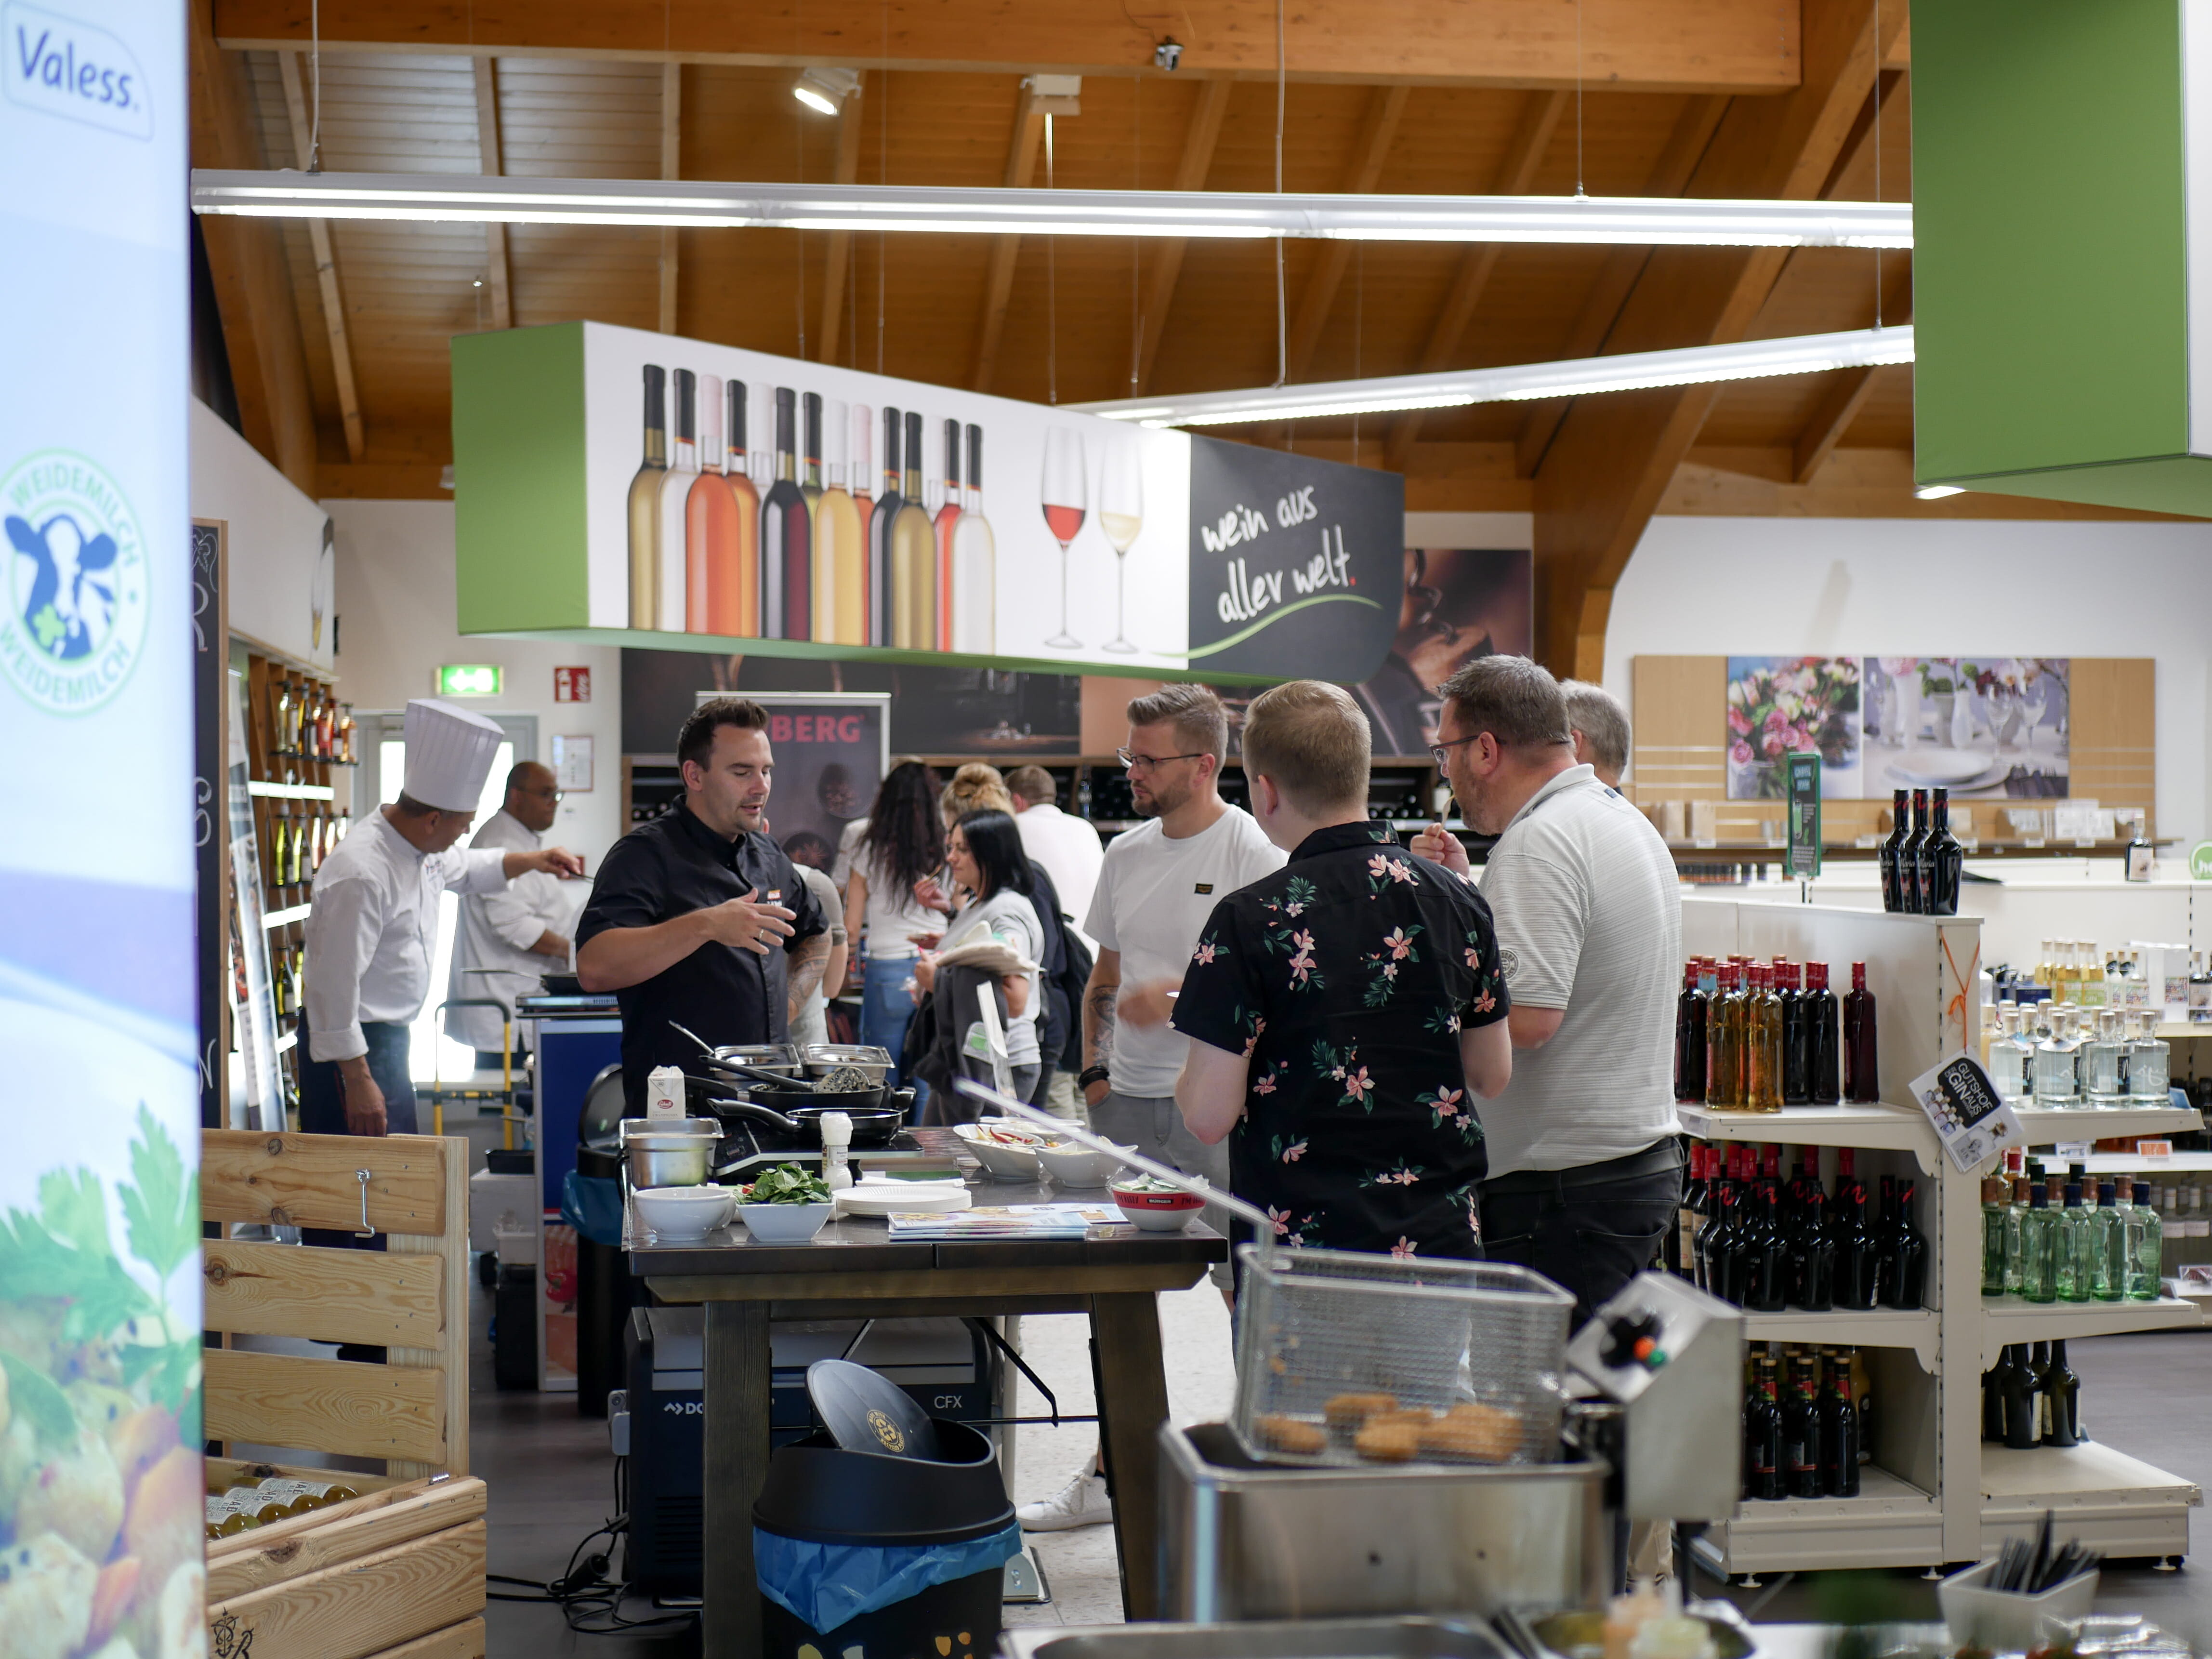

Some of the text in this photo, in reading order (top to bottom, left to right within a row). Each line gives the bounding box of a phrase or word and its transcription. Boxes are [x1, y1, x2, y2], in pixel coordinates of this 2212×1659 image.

[10, 464, 139, 567] WEIDEMILCH
[1201, 485, 1318, 553] wein aus
[1217, 557, 1283, 624] aller
[766, 715, 860, 743] BERG
[1949, 1072, 1970, 1100] GIN
[1964, 1095, 1982, 1115] AUS
[1958, 1062, 1993, 1110] GUTSHOF
[685, 1402, 704, 1415] DO
[934, 1395, 962, 1408] CFX
